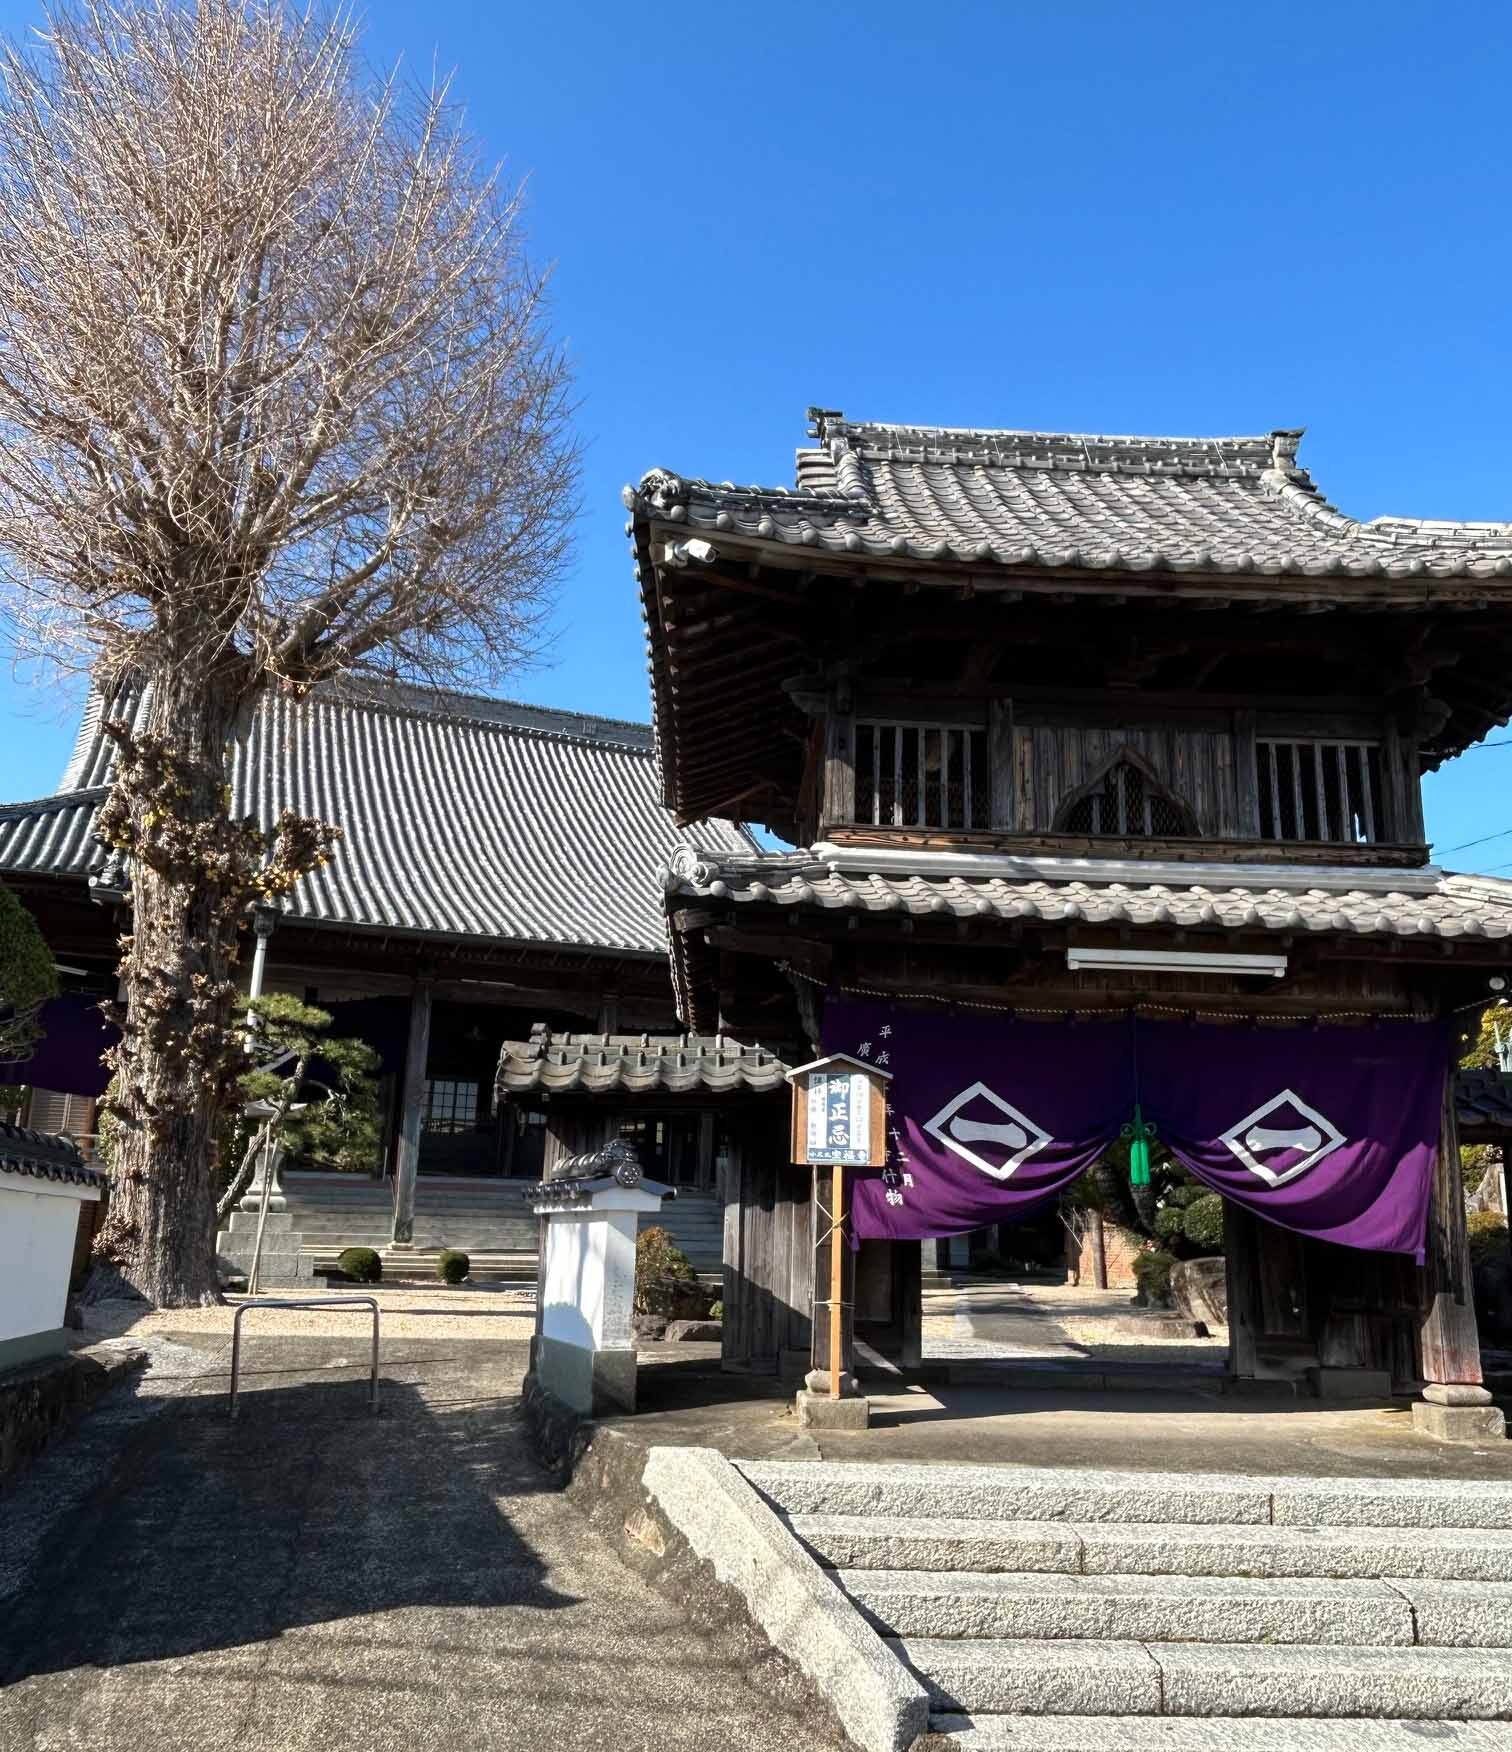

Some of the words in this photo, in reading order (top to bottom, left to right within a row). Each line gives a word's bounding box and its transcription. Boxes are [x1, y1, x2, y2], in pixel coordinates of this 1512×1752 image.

[875, 1024, 914, 1188] 平成年十二月
